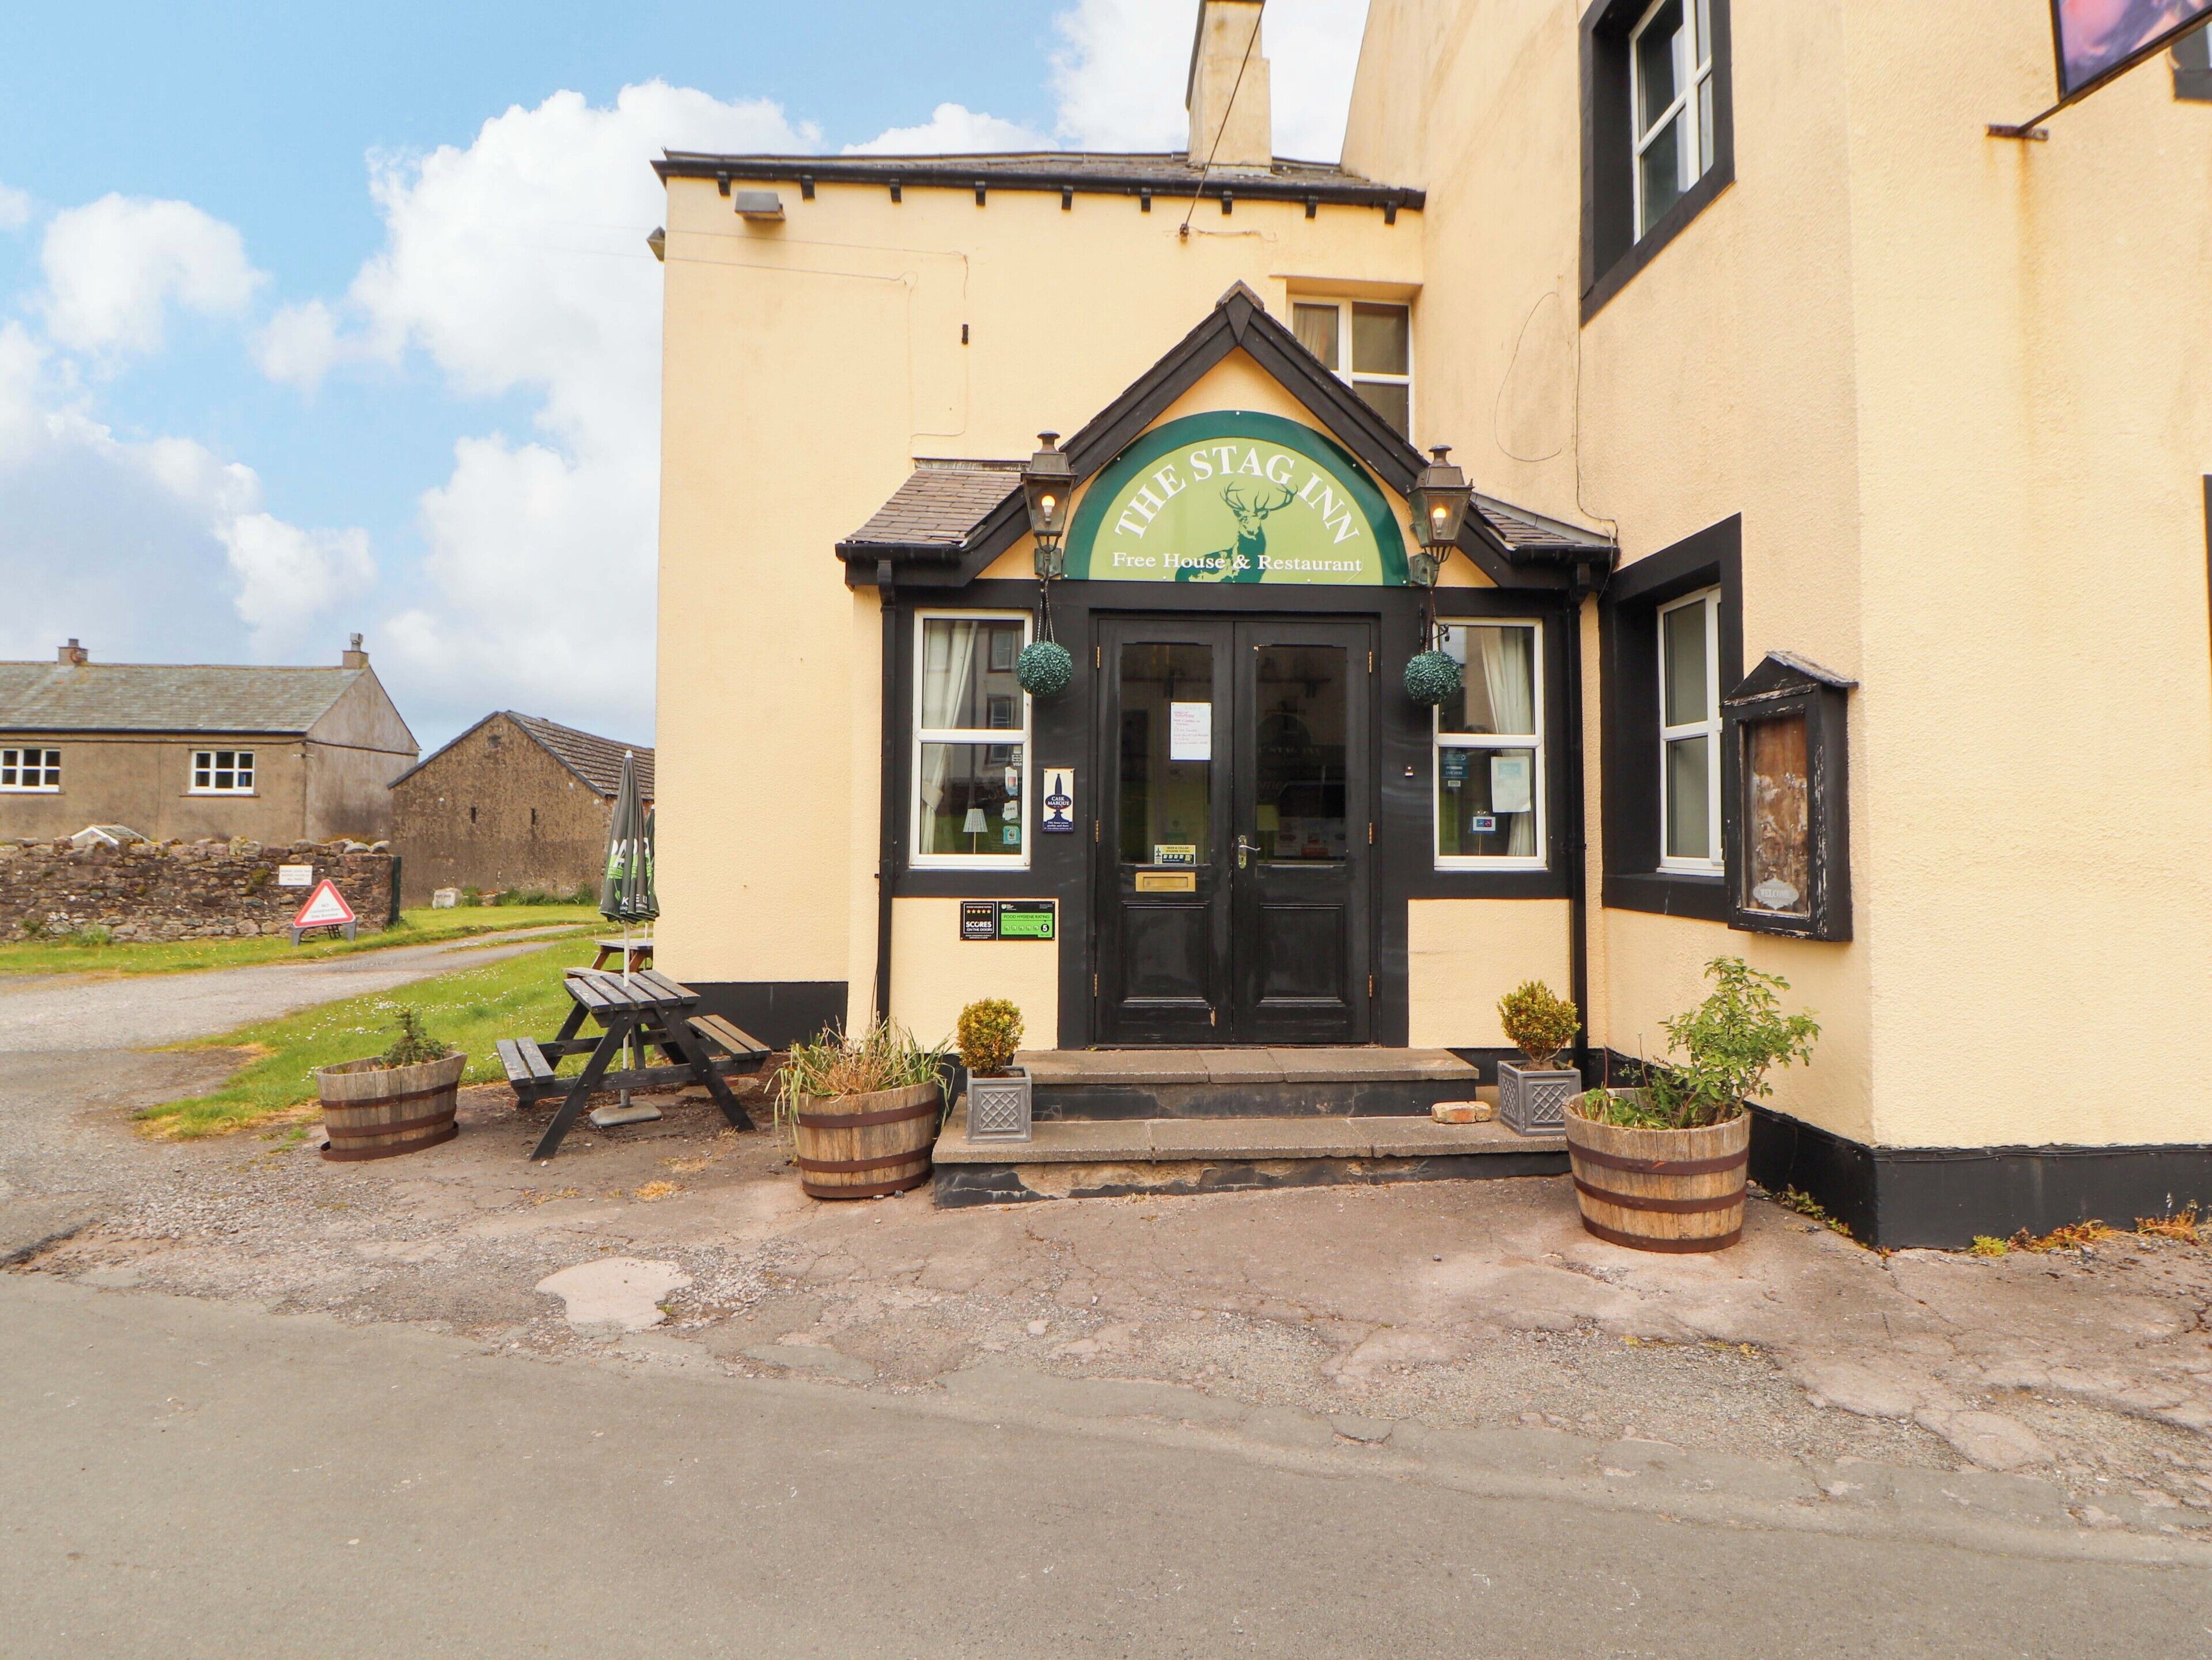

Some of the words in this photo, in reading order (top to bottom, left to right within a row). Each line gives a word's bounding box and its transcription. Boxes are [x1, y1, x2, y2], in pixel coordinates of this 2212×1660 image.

[1114, 464, 1187, 540] THE
[1189, 445, 1296, 487] STAG
[1297, 472, 1360, 545] INN
[1112, 552, 1157, 568] Free
[1162, 553, 1225, 570] House
[1233, 555, 1251, 570] &
[1257, 555, 1362, 572] Restaurant
